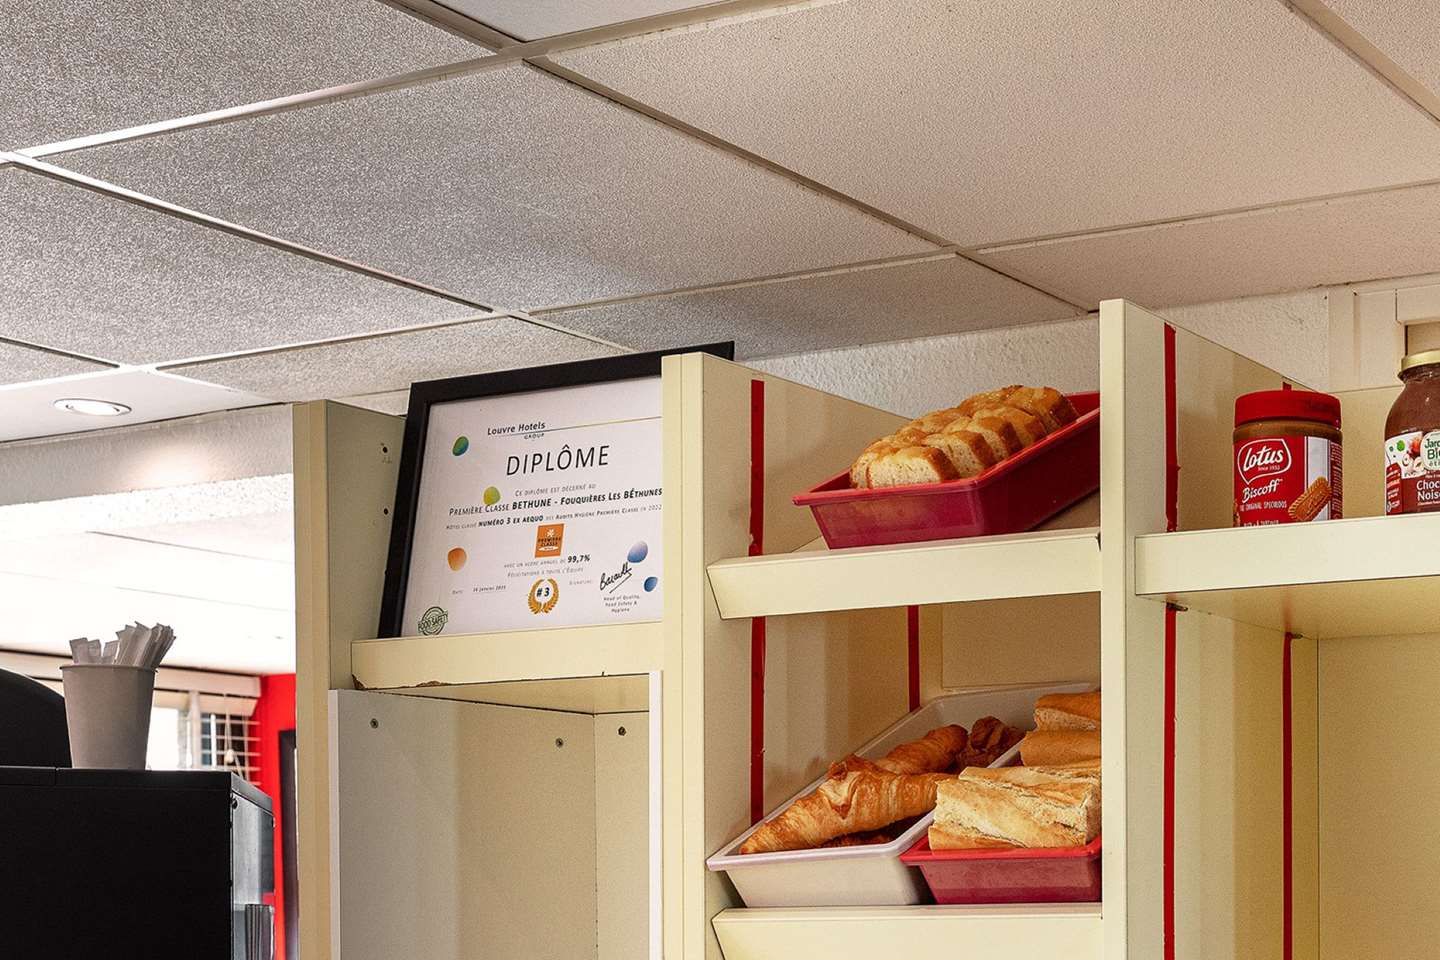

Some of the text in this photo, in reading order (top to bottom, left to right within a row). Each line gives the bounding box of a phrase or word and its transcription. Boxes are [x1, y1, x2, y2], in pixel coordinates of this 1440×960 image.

[487, 421, 546, 436] Louvre Hotels
[506, 443, 610, 476] DIPLÔME
[1242, 479, 1280, 503] Biscoff
[512, 498, 552, 510] BETHUNE
[560, 494, 606, 505] FOUQUIÈRES
[623, 488, 663, 499] BÉTHUNES
[478, 518, 504, 527] NUMÉRO
[506, 517, 511, 525] 3
[523, 515, 544, 523] AEQUO
[567, 554, 591, 563] 99,7%
[544, 587, 550, 597] 3
